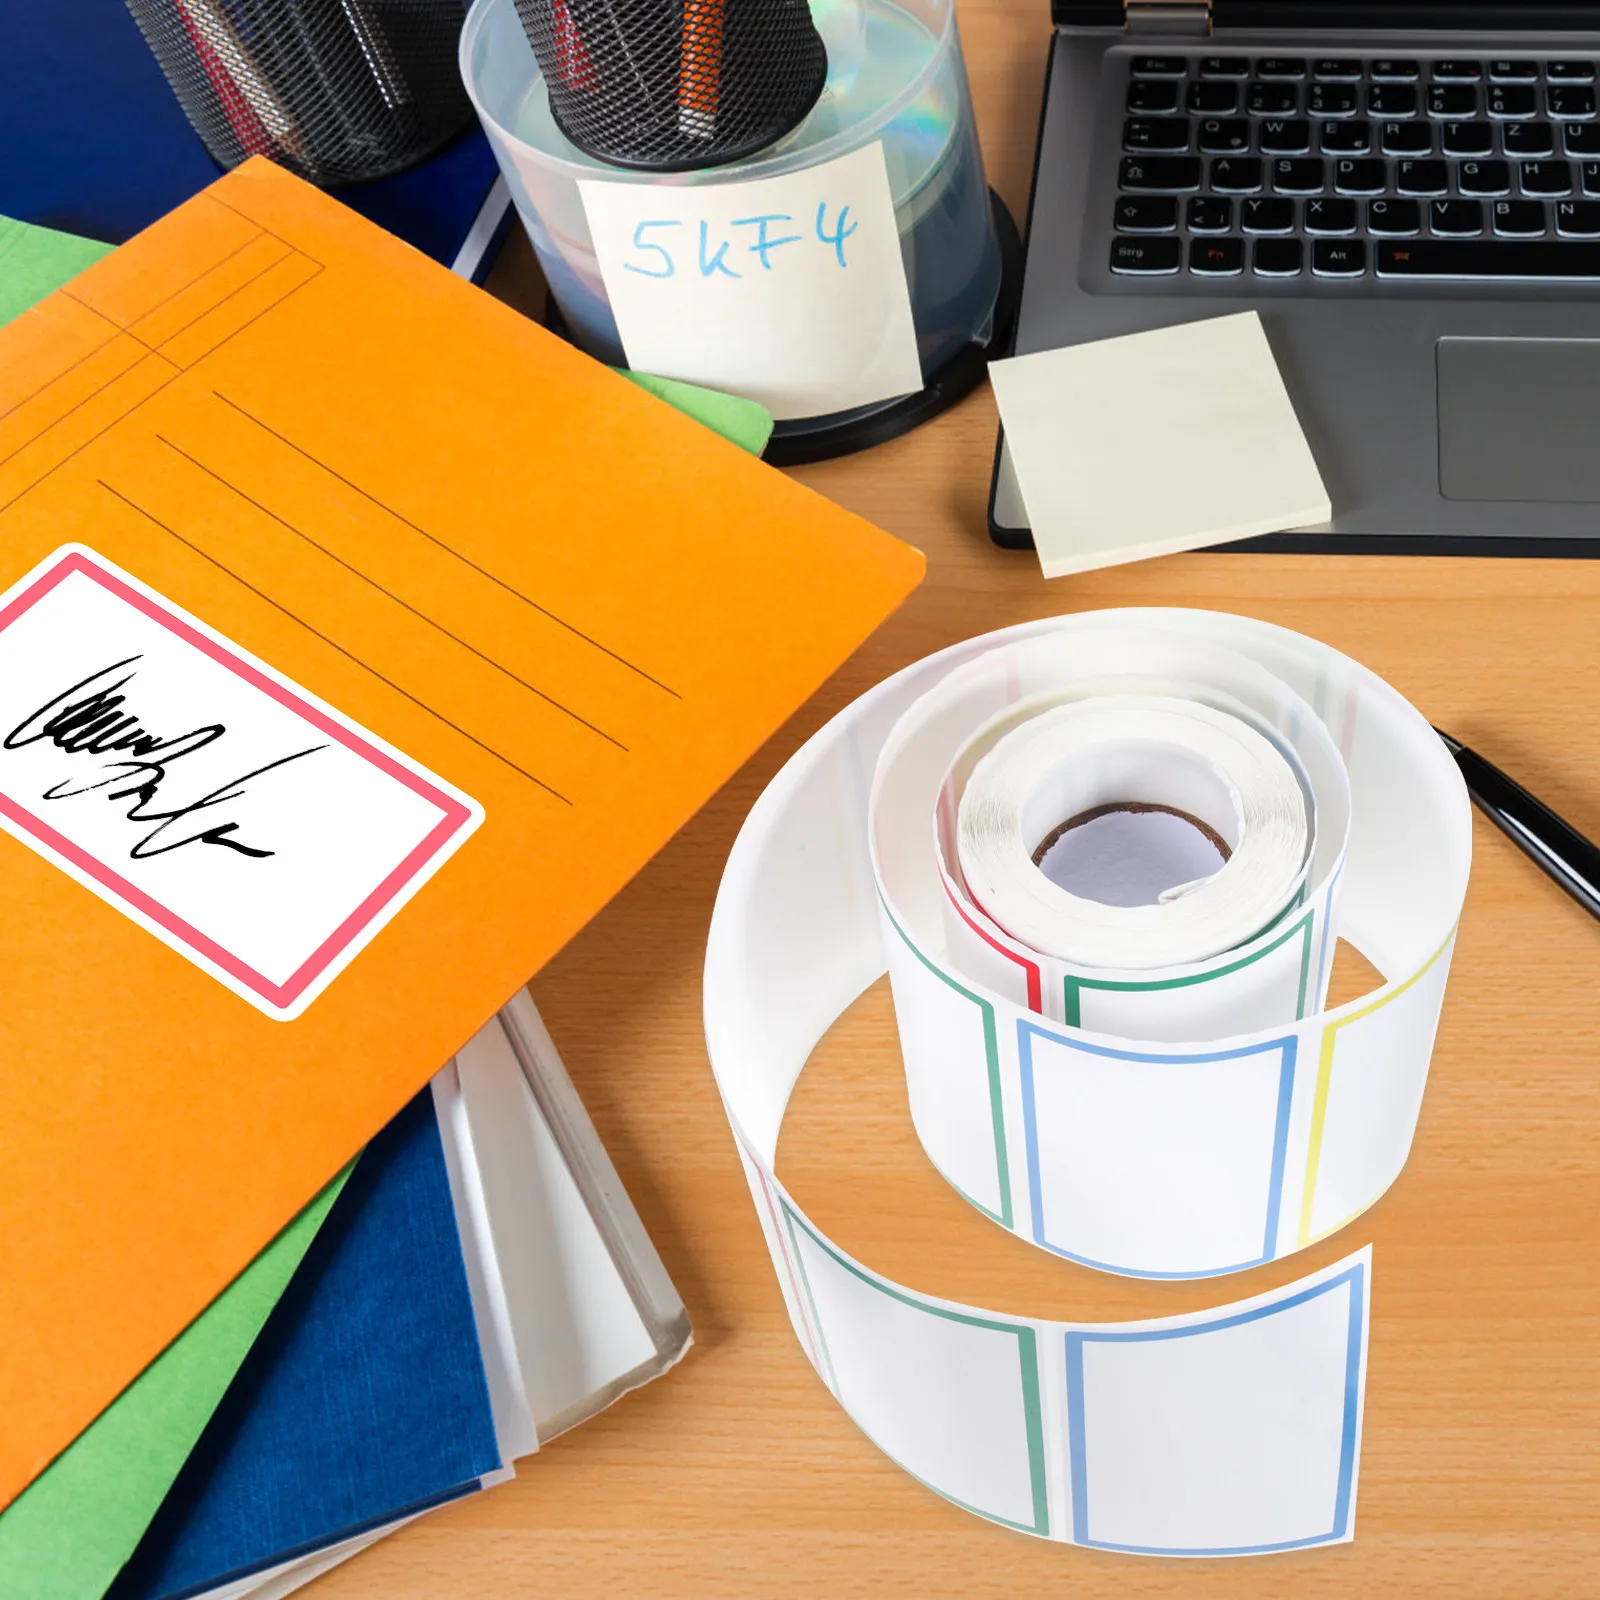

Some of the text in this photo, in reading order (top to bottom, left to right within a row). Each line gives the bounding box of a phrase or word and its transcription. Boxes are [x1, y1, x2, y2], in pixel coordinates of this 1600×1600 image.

[1554, 101, 1563, 110] 7
[1205, 121, 1582, 136] Q W E R T Z U
[1218, 160, 1598, 175] A S D F G H J
[1248, 200, 1574, 215] Y X C V B N
[1119, 248, 1346, 260] Strg Fn Alt
